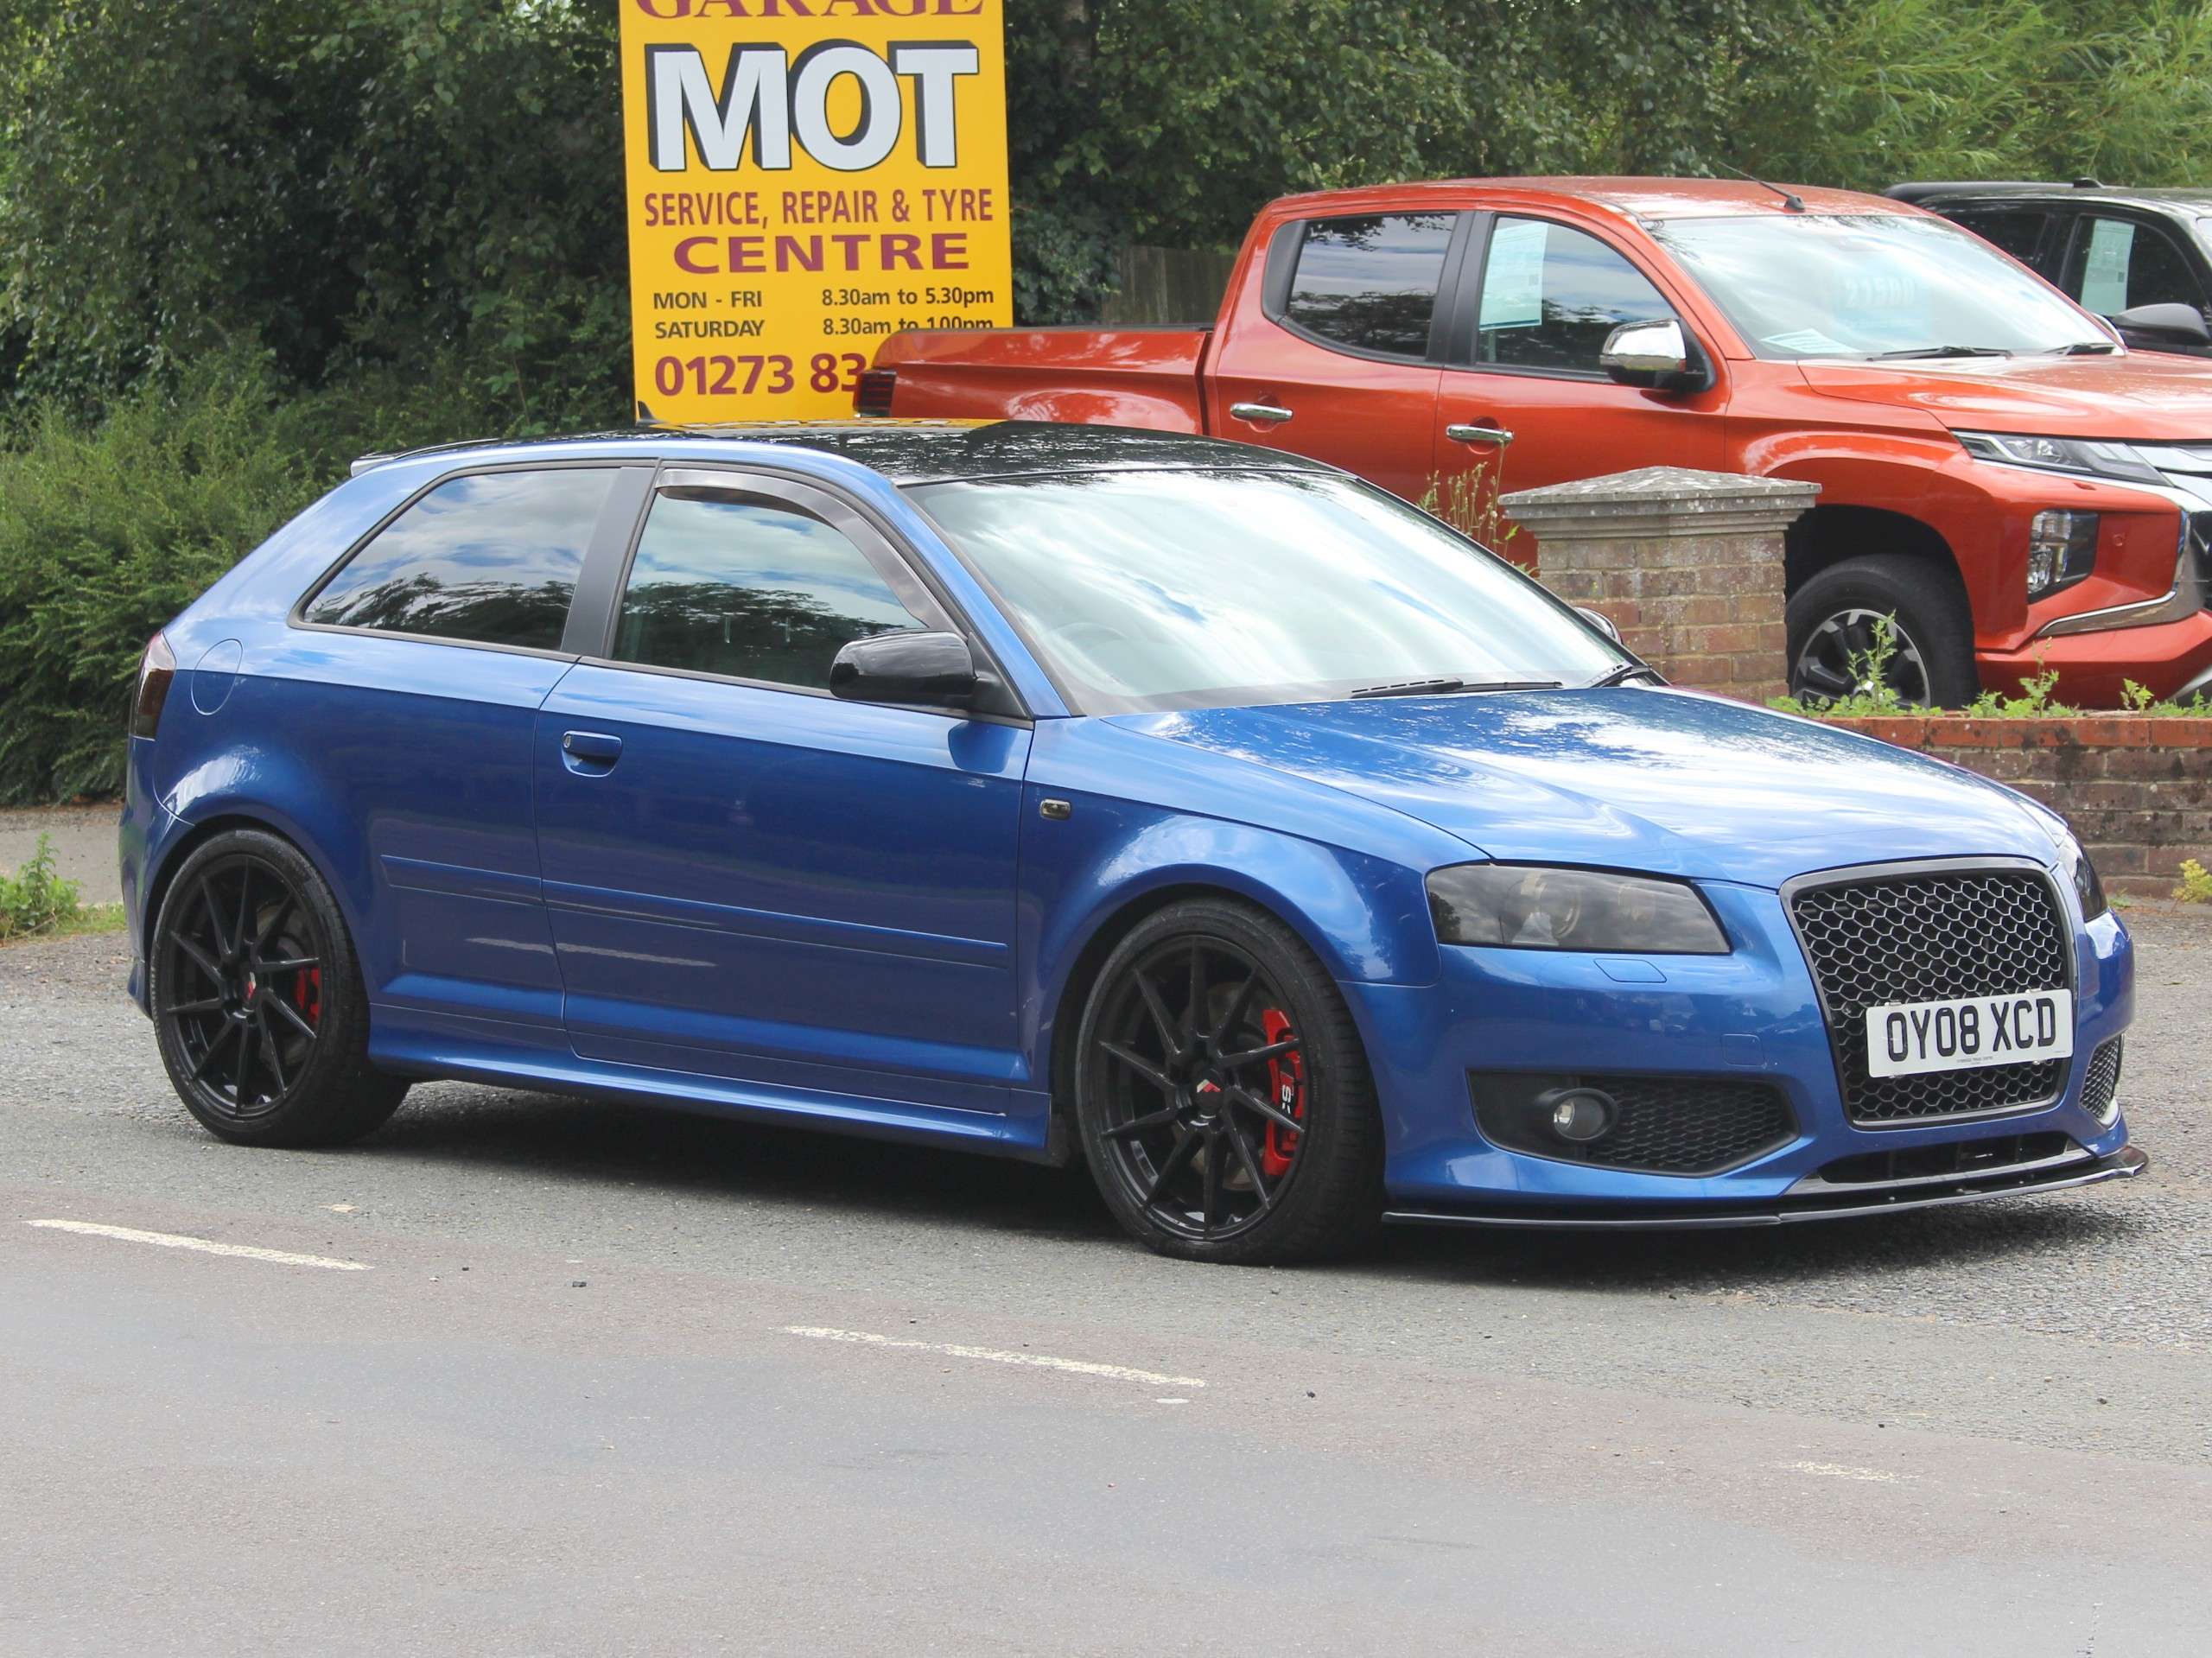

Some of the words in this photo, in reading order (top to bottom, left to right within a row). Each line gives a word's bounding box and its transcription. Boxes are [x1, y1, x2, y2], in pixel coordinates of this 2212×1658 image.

[644, 38, 979, 172] MOT
[645, 192, 767, 229] SERVICE,
[783, 190, 878, 224] REPAIR
[892, 189, 910, 222] &
[922, 188, 993, 221] TYRE
[674, 233, 969, 274] CENTRE
[653, 291, 707, 309] MON
[731, 291, 762, 308] FRI
[822, 289, 891, 306] 8.30am
[897, 289, 918, 305] to
[925, 287, 994, 308] 5.30pm
[655, 320, 765, 339] SATURDAY
[823, 318, 892, 335] 8.30am
[899, 318, 918, 328] to
[655, 355, 794, 397] 01273
[1886, 1005, 1980, 1062] OY08
[1990, 997, 2056, 1051] XCD
